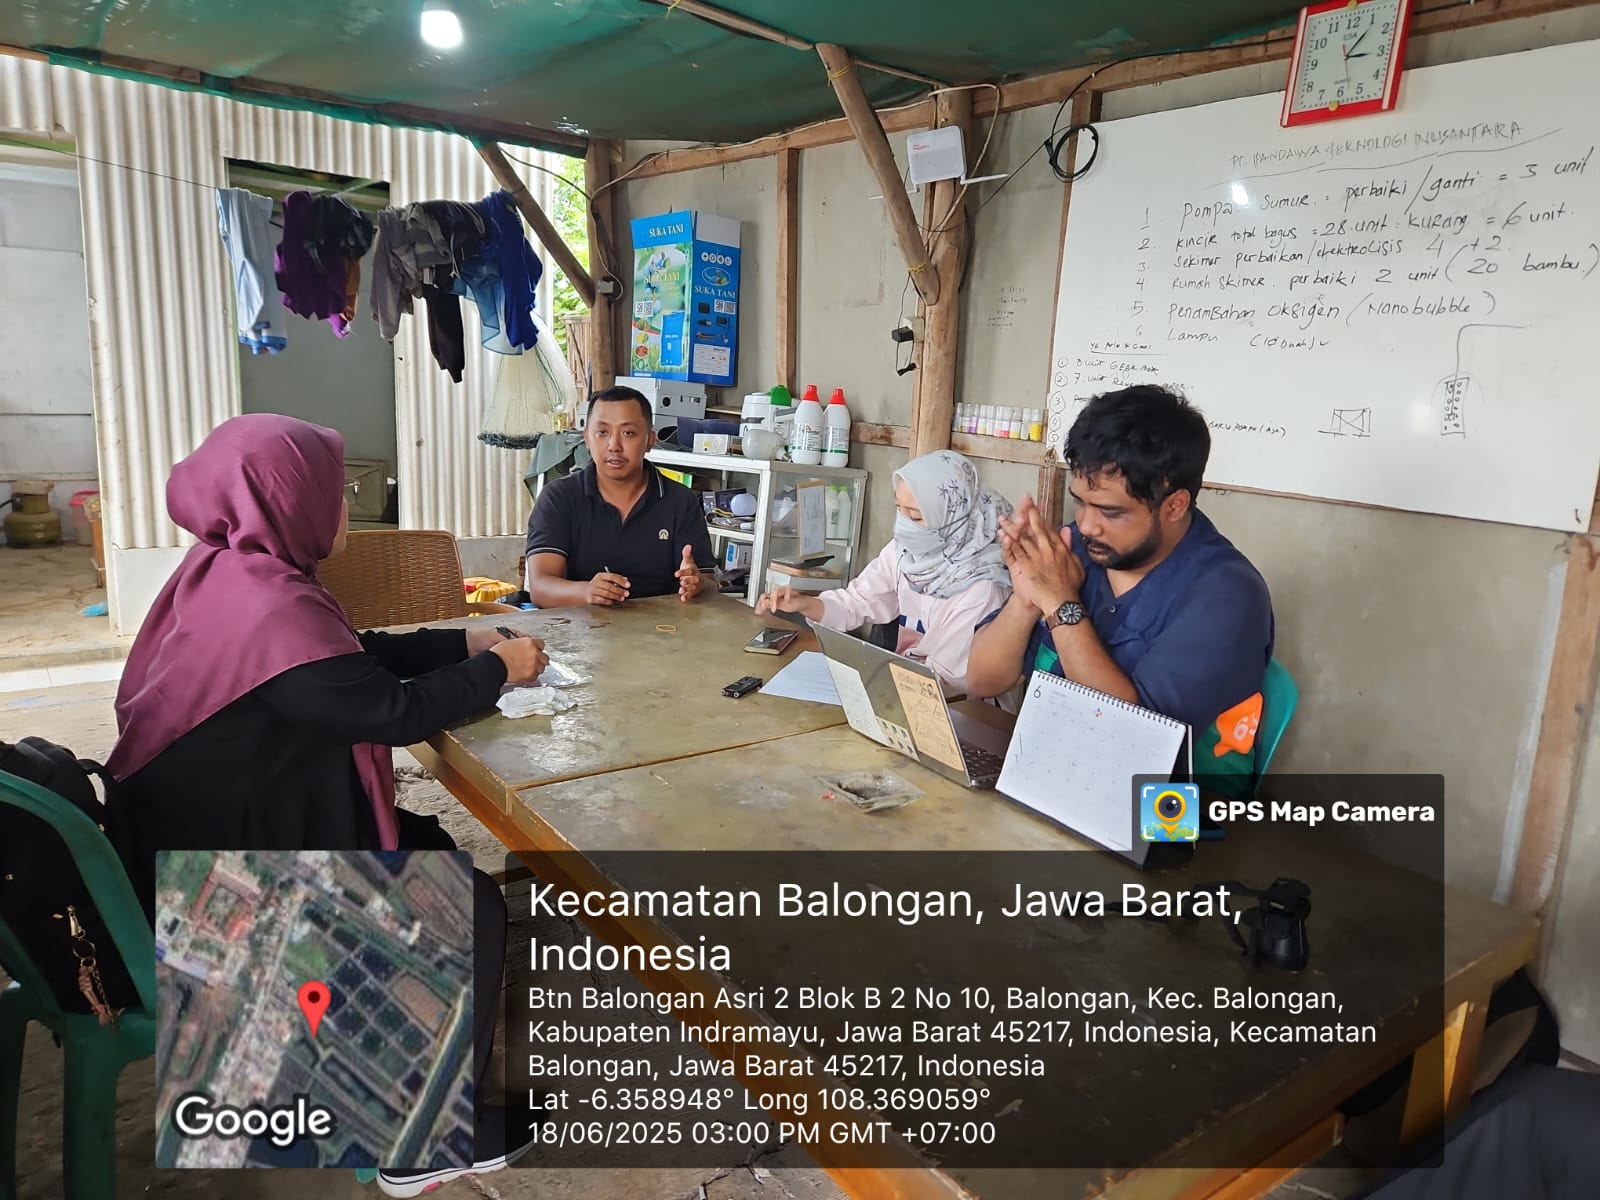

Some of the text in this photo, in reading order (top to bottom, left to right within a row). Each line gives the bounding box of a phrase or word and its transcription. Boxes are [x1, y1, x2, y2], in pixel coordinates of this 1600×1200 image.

[1346, 16, 1361, 30] 12
[1370, 13, 1376, 25] 1
[1328, 22, 1339, 34] 11
[1381, 22, 1390, 35] 2
[1314, 37, 1328, 50] 10
[1376, 45, 1385, 57] 3
[1310, 59, 1318, 70] 9
[1372, 68, 1380, 81] 4
[1305, 81, 1314, 93] 8
[1336, 86, 1344, 97] 6
[1355, 82, 1364, 94] 5
[1319, 89, 1326, 100] 7
[648, 223, 684, 238] SUKA TANI
[694, 285, 737, 299] SUKA TANI
[1033, 685, 1042, 699] 6
